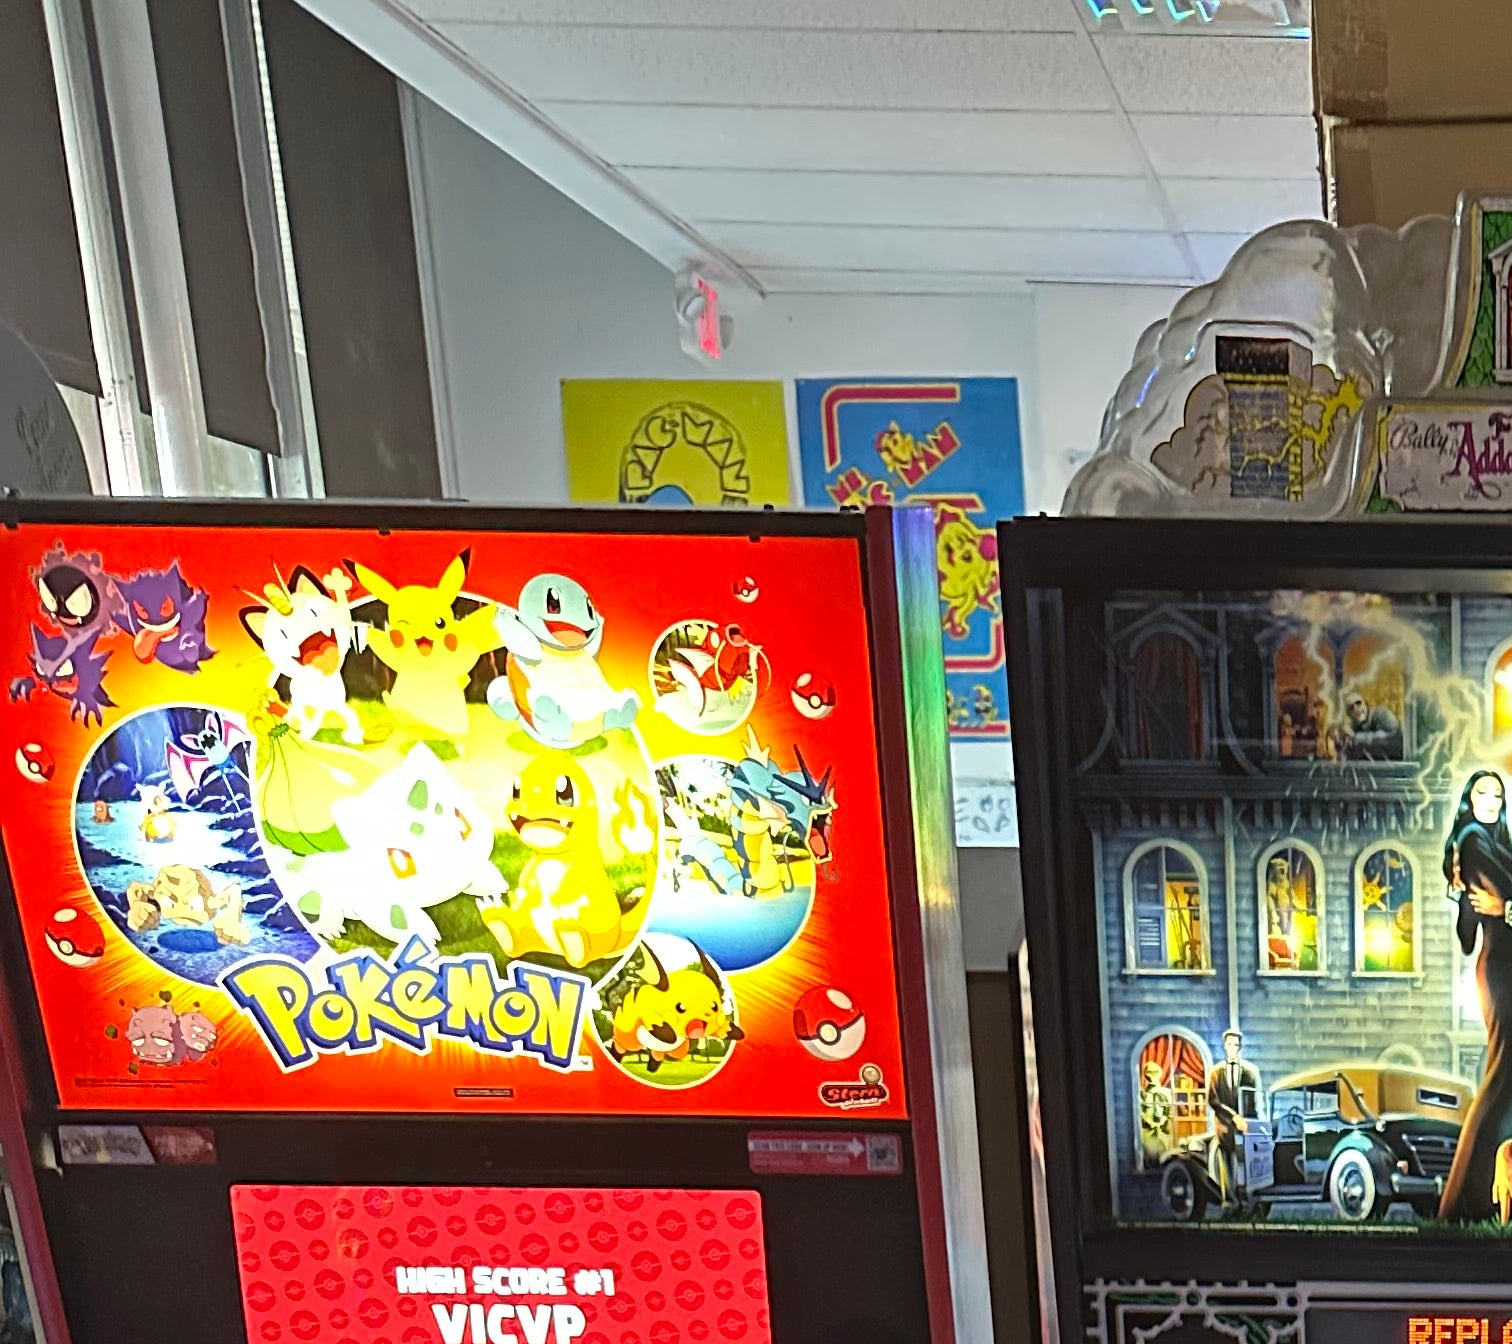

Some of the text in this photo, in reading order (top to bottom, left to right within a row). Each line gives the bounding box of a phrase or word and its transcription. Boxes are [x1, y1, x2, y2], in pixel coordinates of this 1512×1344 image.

[1390, 421, 1449, 458] Bally
[826, 1086, 881, 1102] Stern
[395, 1265, 616, 1297] HIGH SCORE #1
